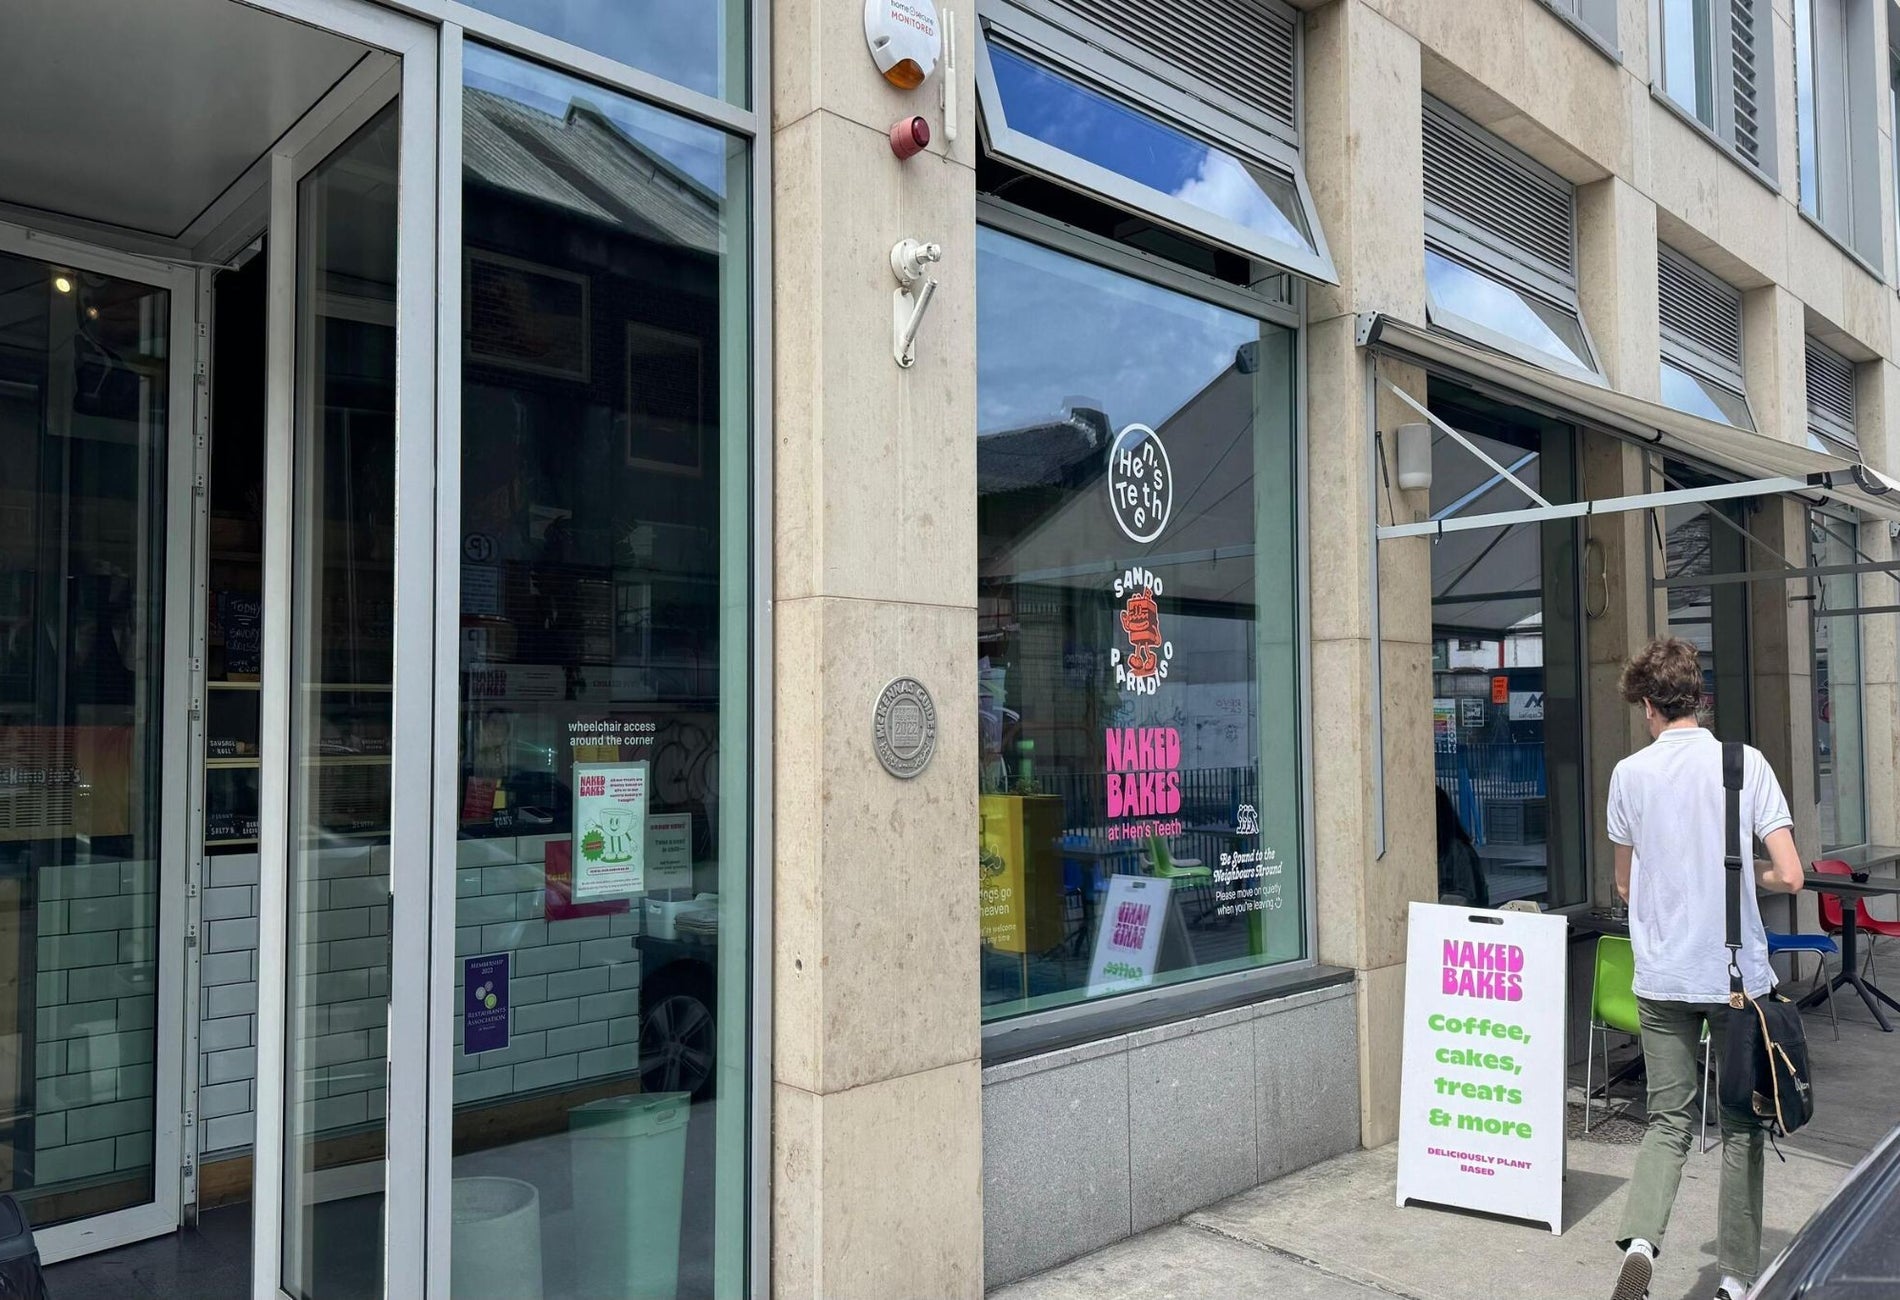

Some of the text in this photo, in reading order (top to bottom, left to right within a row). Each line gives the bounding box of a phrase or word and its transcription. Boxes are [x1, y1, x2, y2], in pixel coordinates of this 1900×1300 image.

[892, 11, 933, 36] MONITORED
[1119, 441, 1163, 490] Hen's
[1115, 482, 1162, 528] Teeth
[1113, 566, 1164, 598] SANDO
[1110, 641, 1174, 696] PARADISO
[916, 688, 935, 738] GUIDES
[568, 720, 656, 732] wheelchair access
[569, 734, 654, 746] around the corner
[1105, 727, 1181, 771] NAKED
[579, 786, 606, 797] BAKES
[580, 775, 606, 787] NAKED
[1107, 771, 1181, 818] BAKES
[1108, 818, 1182, 841] at Hen's Teeth
[1220, 847, 1275, 868] Be Sound to the
[1213, 861, 1283, 885] Neighbours Around
[1000, 888, 1012, 901] go
[1215, 882, 1282, 902] Please move on quietly
[1217, 899, 1274, 916] when you're leaving
[470, 959, 504, 969] MEMBERSHIP
[1442, 939, 1524, 973] NAKED
[481, 967, 494, 975] 2022
[1442, 967, 1523, 1002] BAKES
[467, 1007, 507, 1018] RESTAURANTS
[468, 1014, 506, 1026] ASSOCIATION
[1427, 1013, 1532, 1044] Coffee,
[1435, 1047, 1523, 1075] cakes,
[1433, 1076, 1523, 1105] treats
[1428, 1108, 1533, 1139] & more
[1427, 1147, 1533, 1170] DELICIOUSLY PLANT
[1460, 1164, 1495, 1176] BASED
